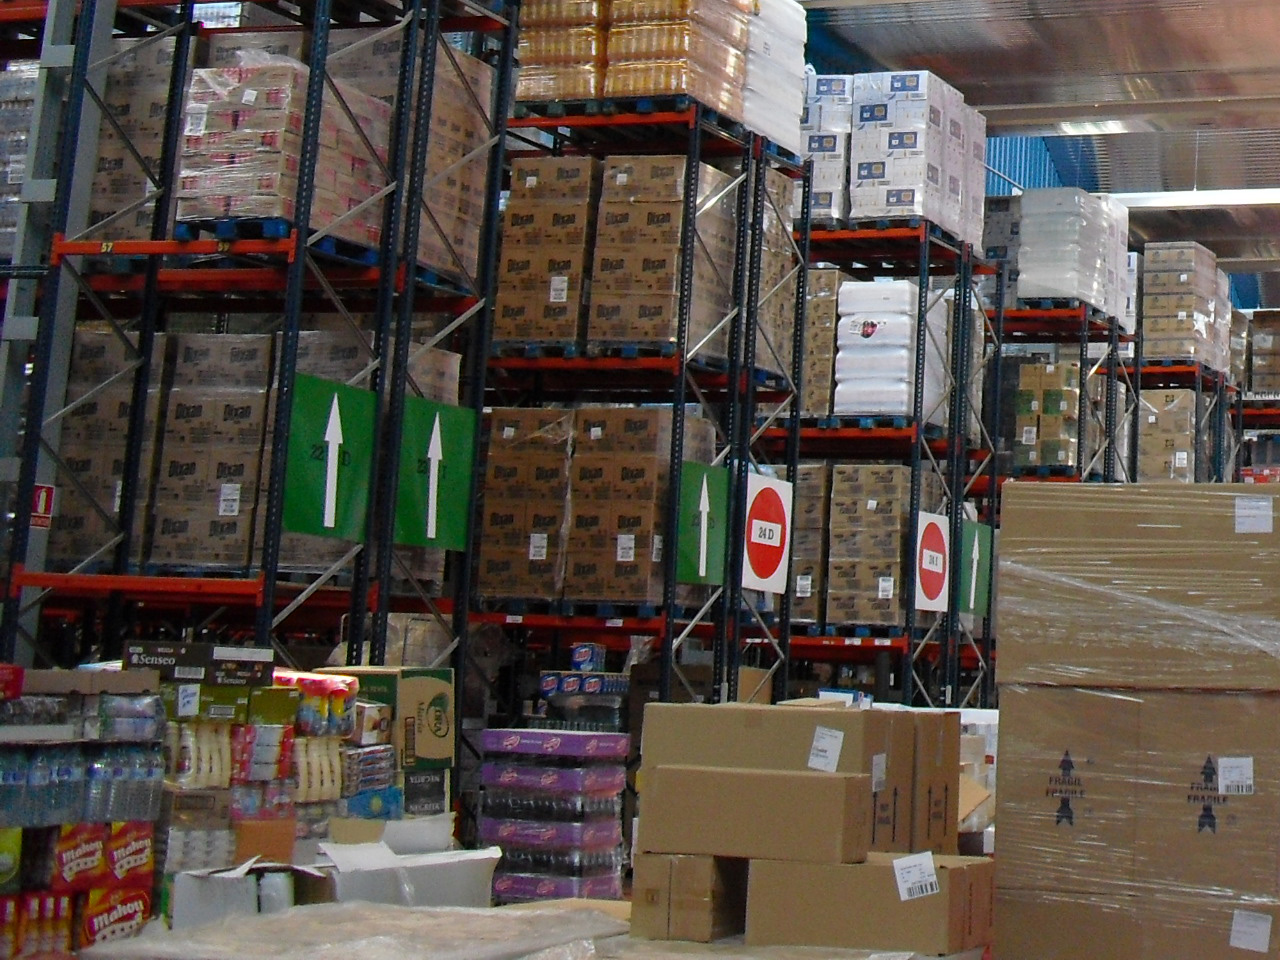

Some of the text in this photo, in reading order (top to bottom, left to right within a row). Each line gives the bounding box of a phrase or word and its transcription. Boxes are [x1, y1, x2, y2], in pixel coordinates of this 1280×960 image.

[647, 211, 671, 226] Dixan
[101, 242, 113, 252] 57
[223, 404, 251, 421] Dixan
[168, 460, 196, 477] Dixan
[217, 462, 244, 479] Dixan
[758, 527, 774, 540] 24 D
[139, 654, 175, 666] Senseo
[1049, 776, 1082, 787] FRAGIL
